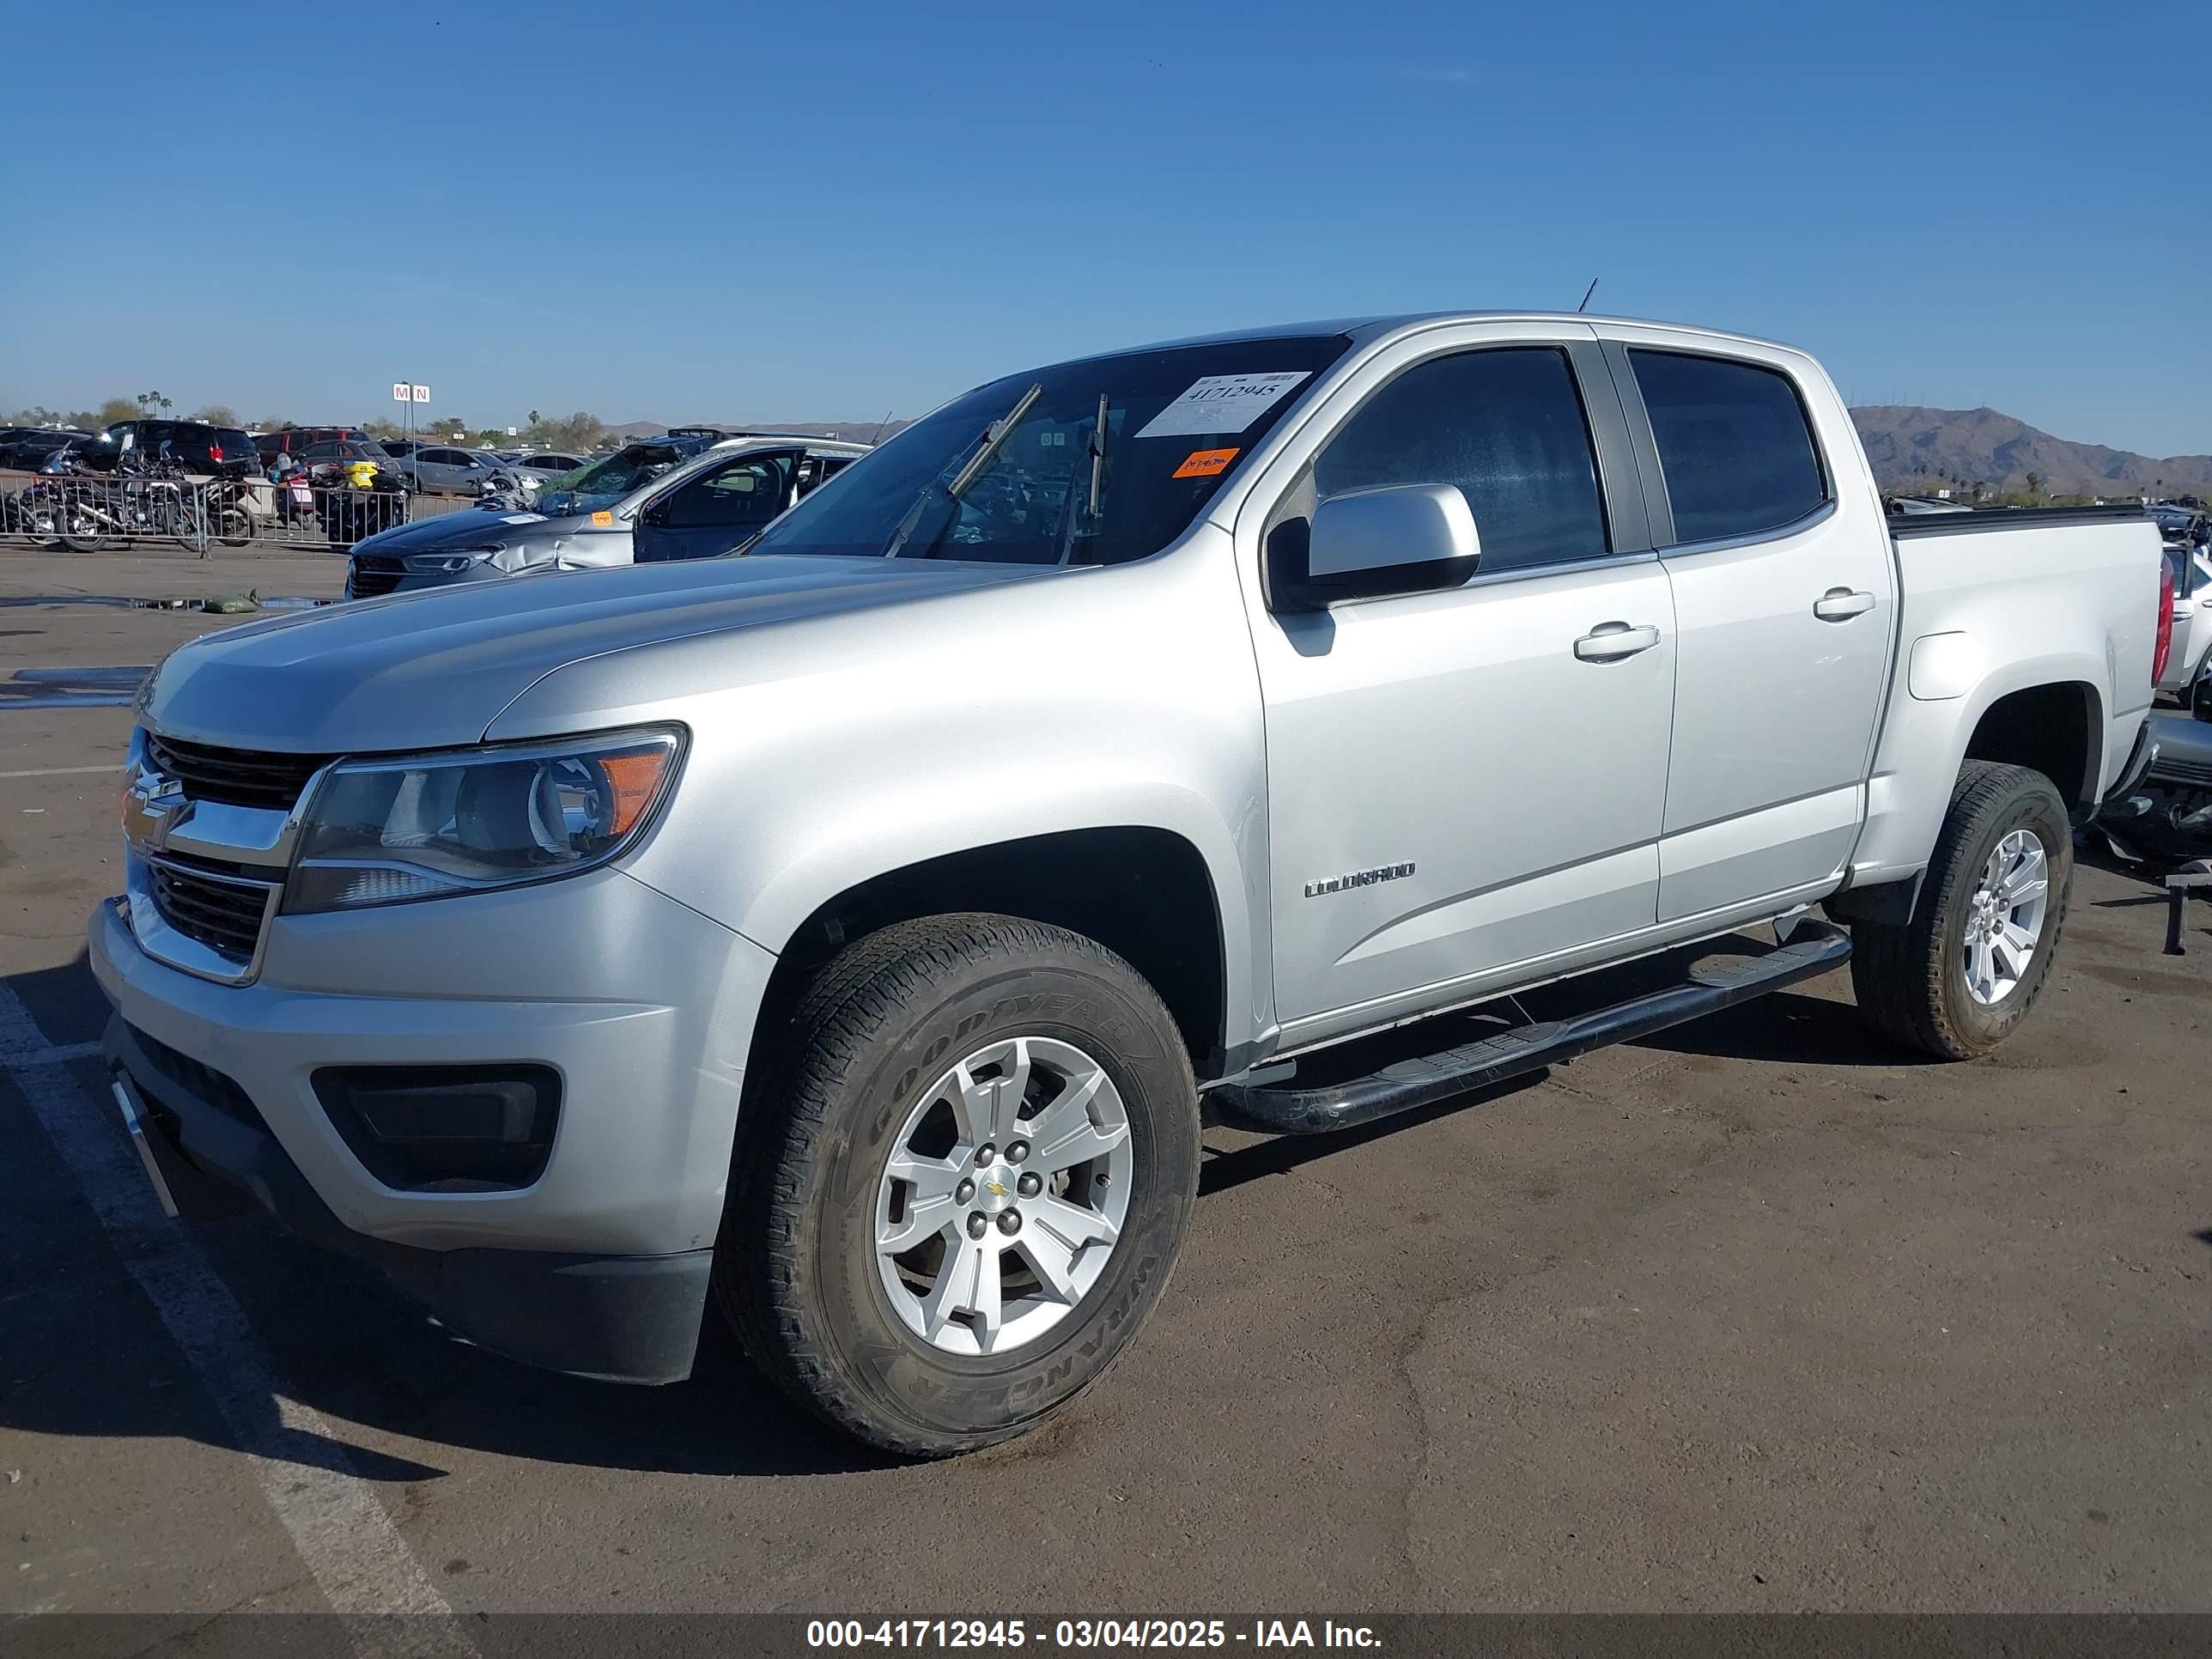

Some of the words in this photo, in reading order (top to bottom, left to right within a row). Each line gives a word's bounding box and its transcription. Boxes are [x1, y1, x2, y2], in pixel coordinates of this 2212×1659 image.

[396, 386, 408, 398] M
[416, 388, 427, 400] N
[1188, 384, 1280, 400] 41712945
[1304, 860, 1416, 898] COLORADO
[868, 992, 1132, 1147] GOODYEAR
[908, 1255, 1157, 1408] WRANGLER
